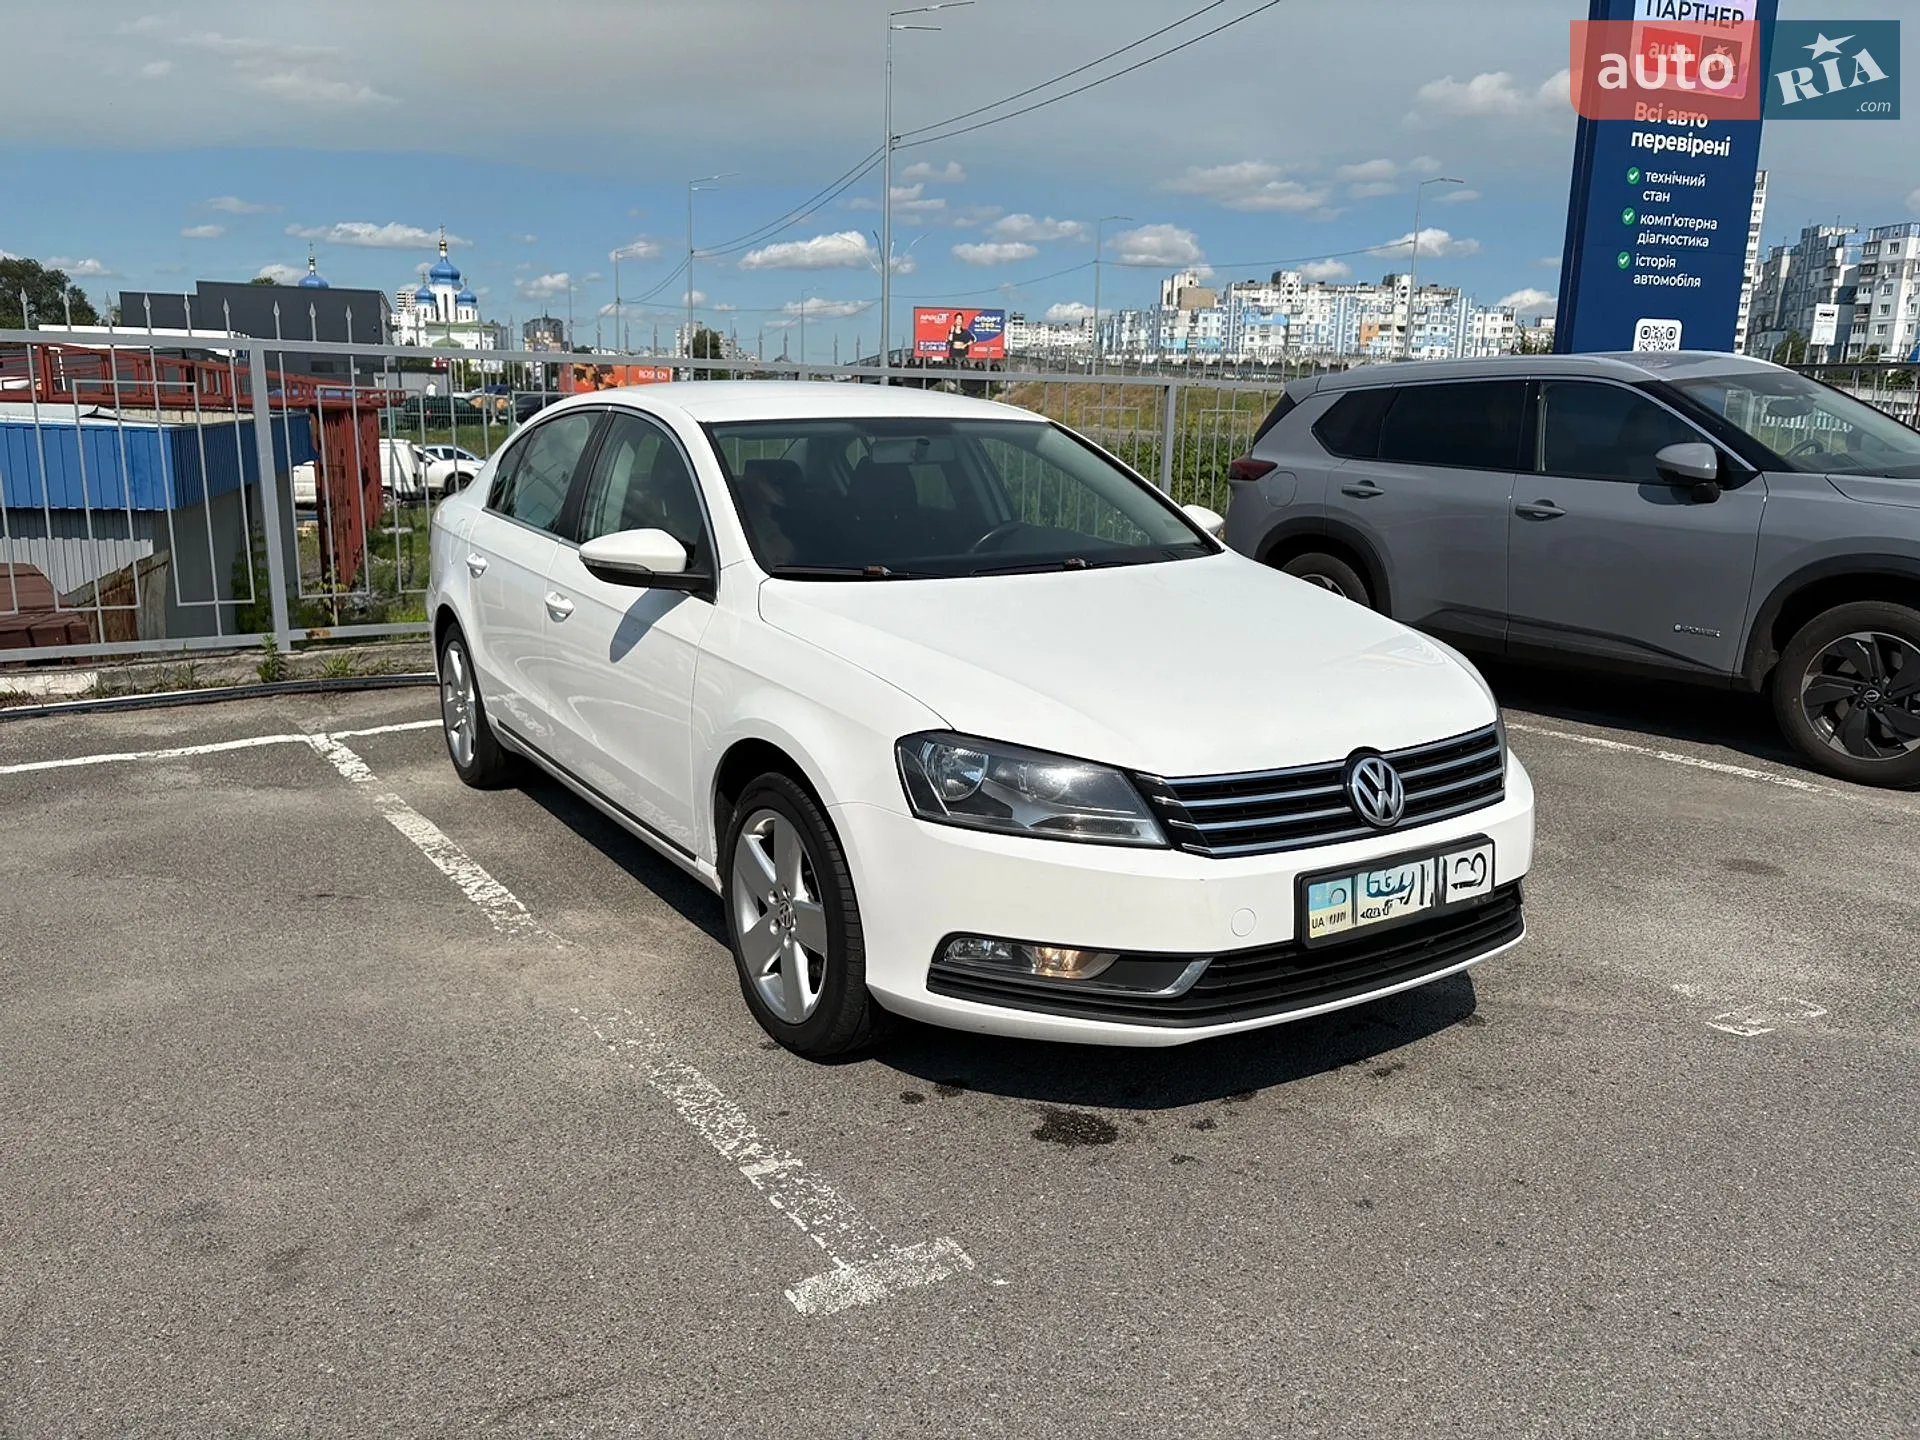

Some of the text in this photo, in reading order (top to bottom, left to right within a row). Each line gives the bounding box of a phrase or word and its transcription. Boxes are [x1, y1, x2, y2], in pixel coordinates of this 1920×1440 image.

[1646, 0, 1745, 29] ПАРТНЕР
[1634, 101, 1709, 128] Всі авто
[1630, 131, 1732, 158] перевірені
[1645, 170, 1706, 187] технічний
[1642, 190, 1671, 203] стан
[1640, 213, 1718, 232] комп'ютерна
[1636, 229, 1710, 248] діагностика
[1635, 252, 1677, 270] історія
[1633, 273, 1702, 288] автомобіля
[1311, 917, 1325, 929] UA
